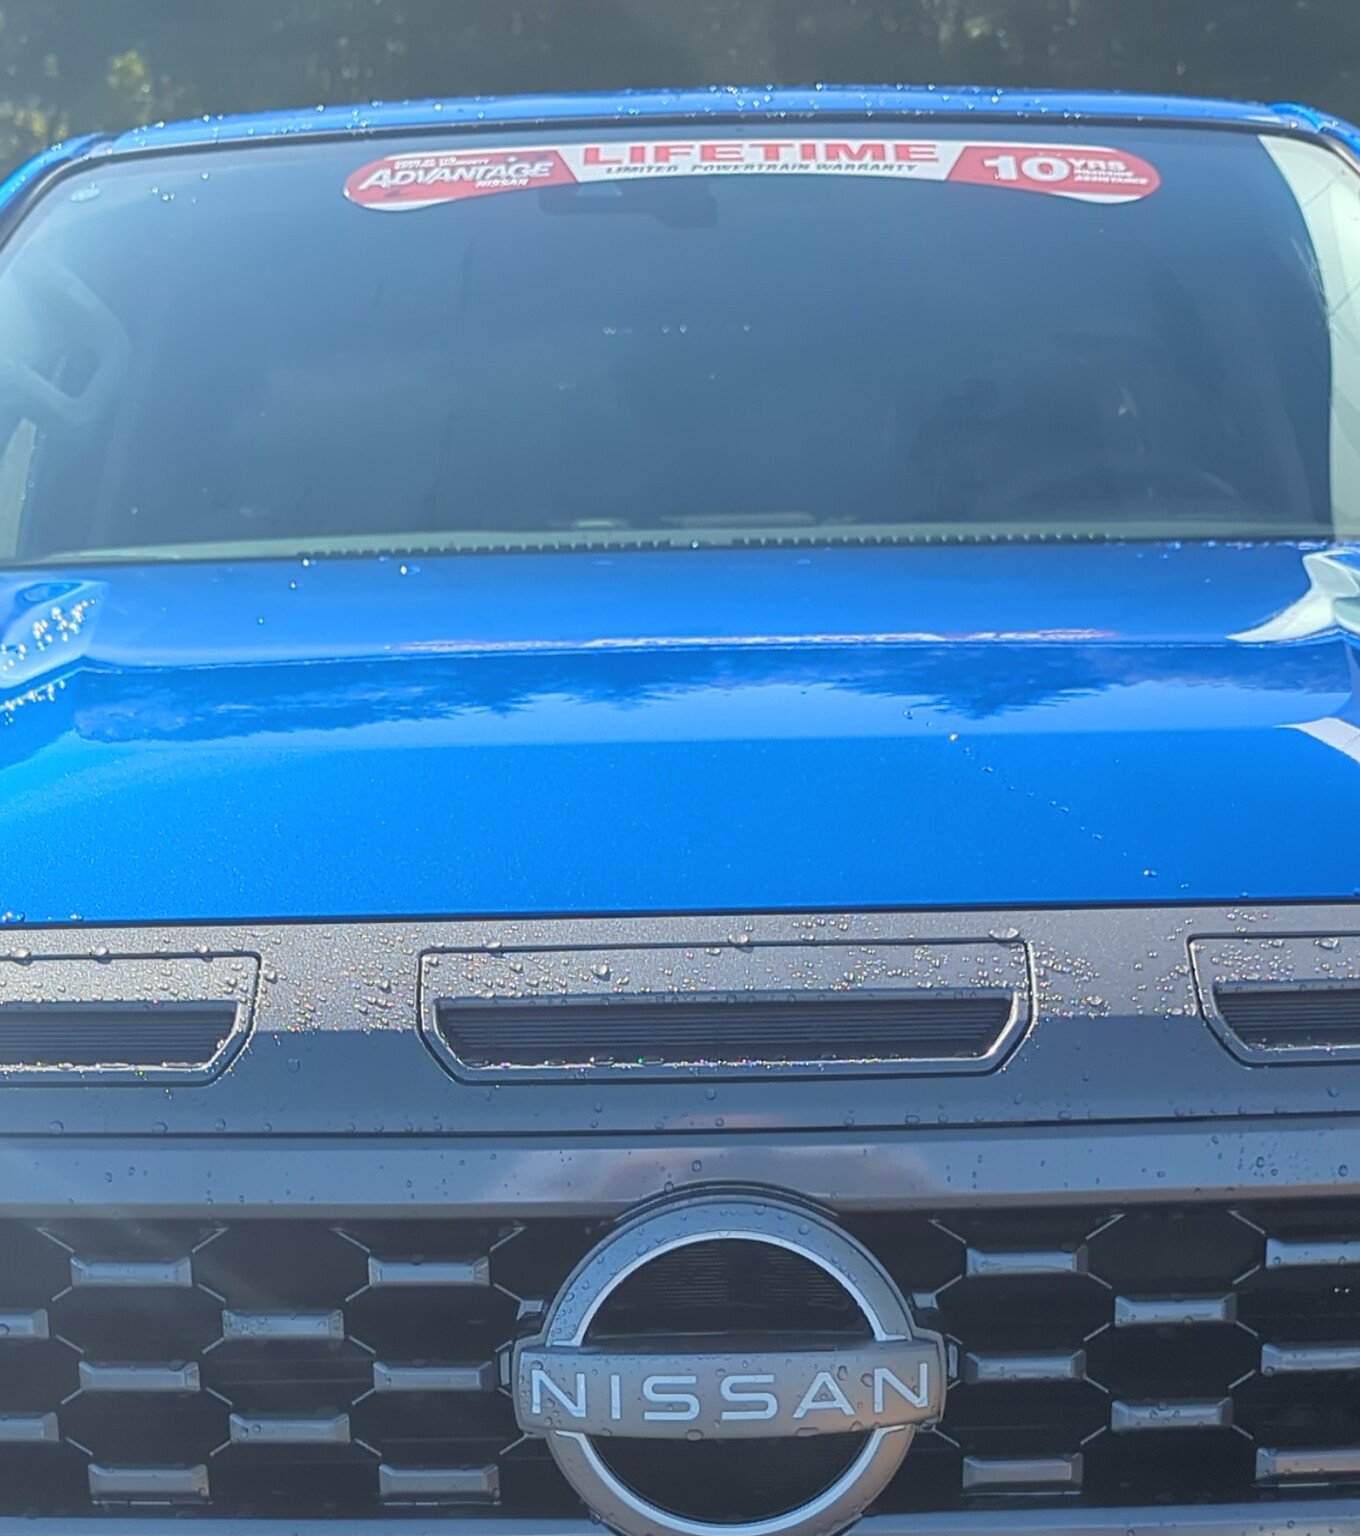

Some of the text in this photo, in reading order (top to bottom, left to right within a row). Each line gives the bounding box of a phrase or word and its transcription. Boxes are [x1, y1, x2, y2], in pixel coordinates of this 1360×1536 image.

[583, 142, 940, 166] LIFETIME
[983, 154, 1071, 181] 10
[358, 160, 555, 191] ADVANTAGE
[605, 164, 678, 174] LIMITED
[814, 162, 918, 173] WARRANTY
[530, 1362, 929, 1422] NISSAN
